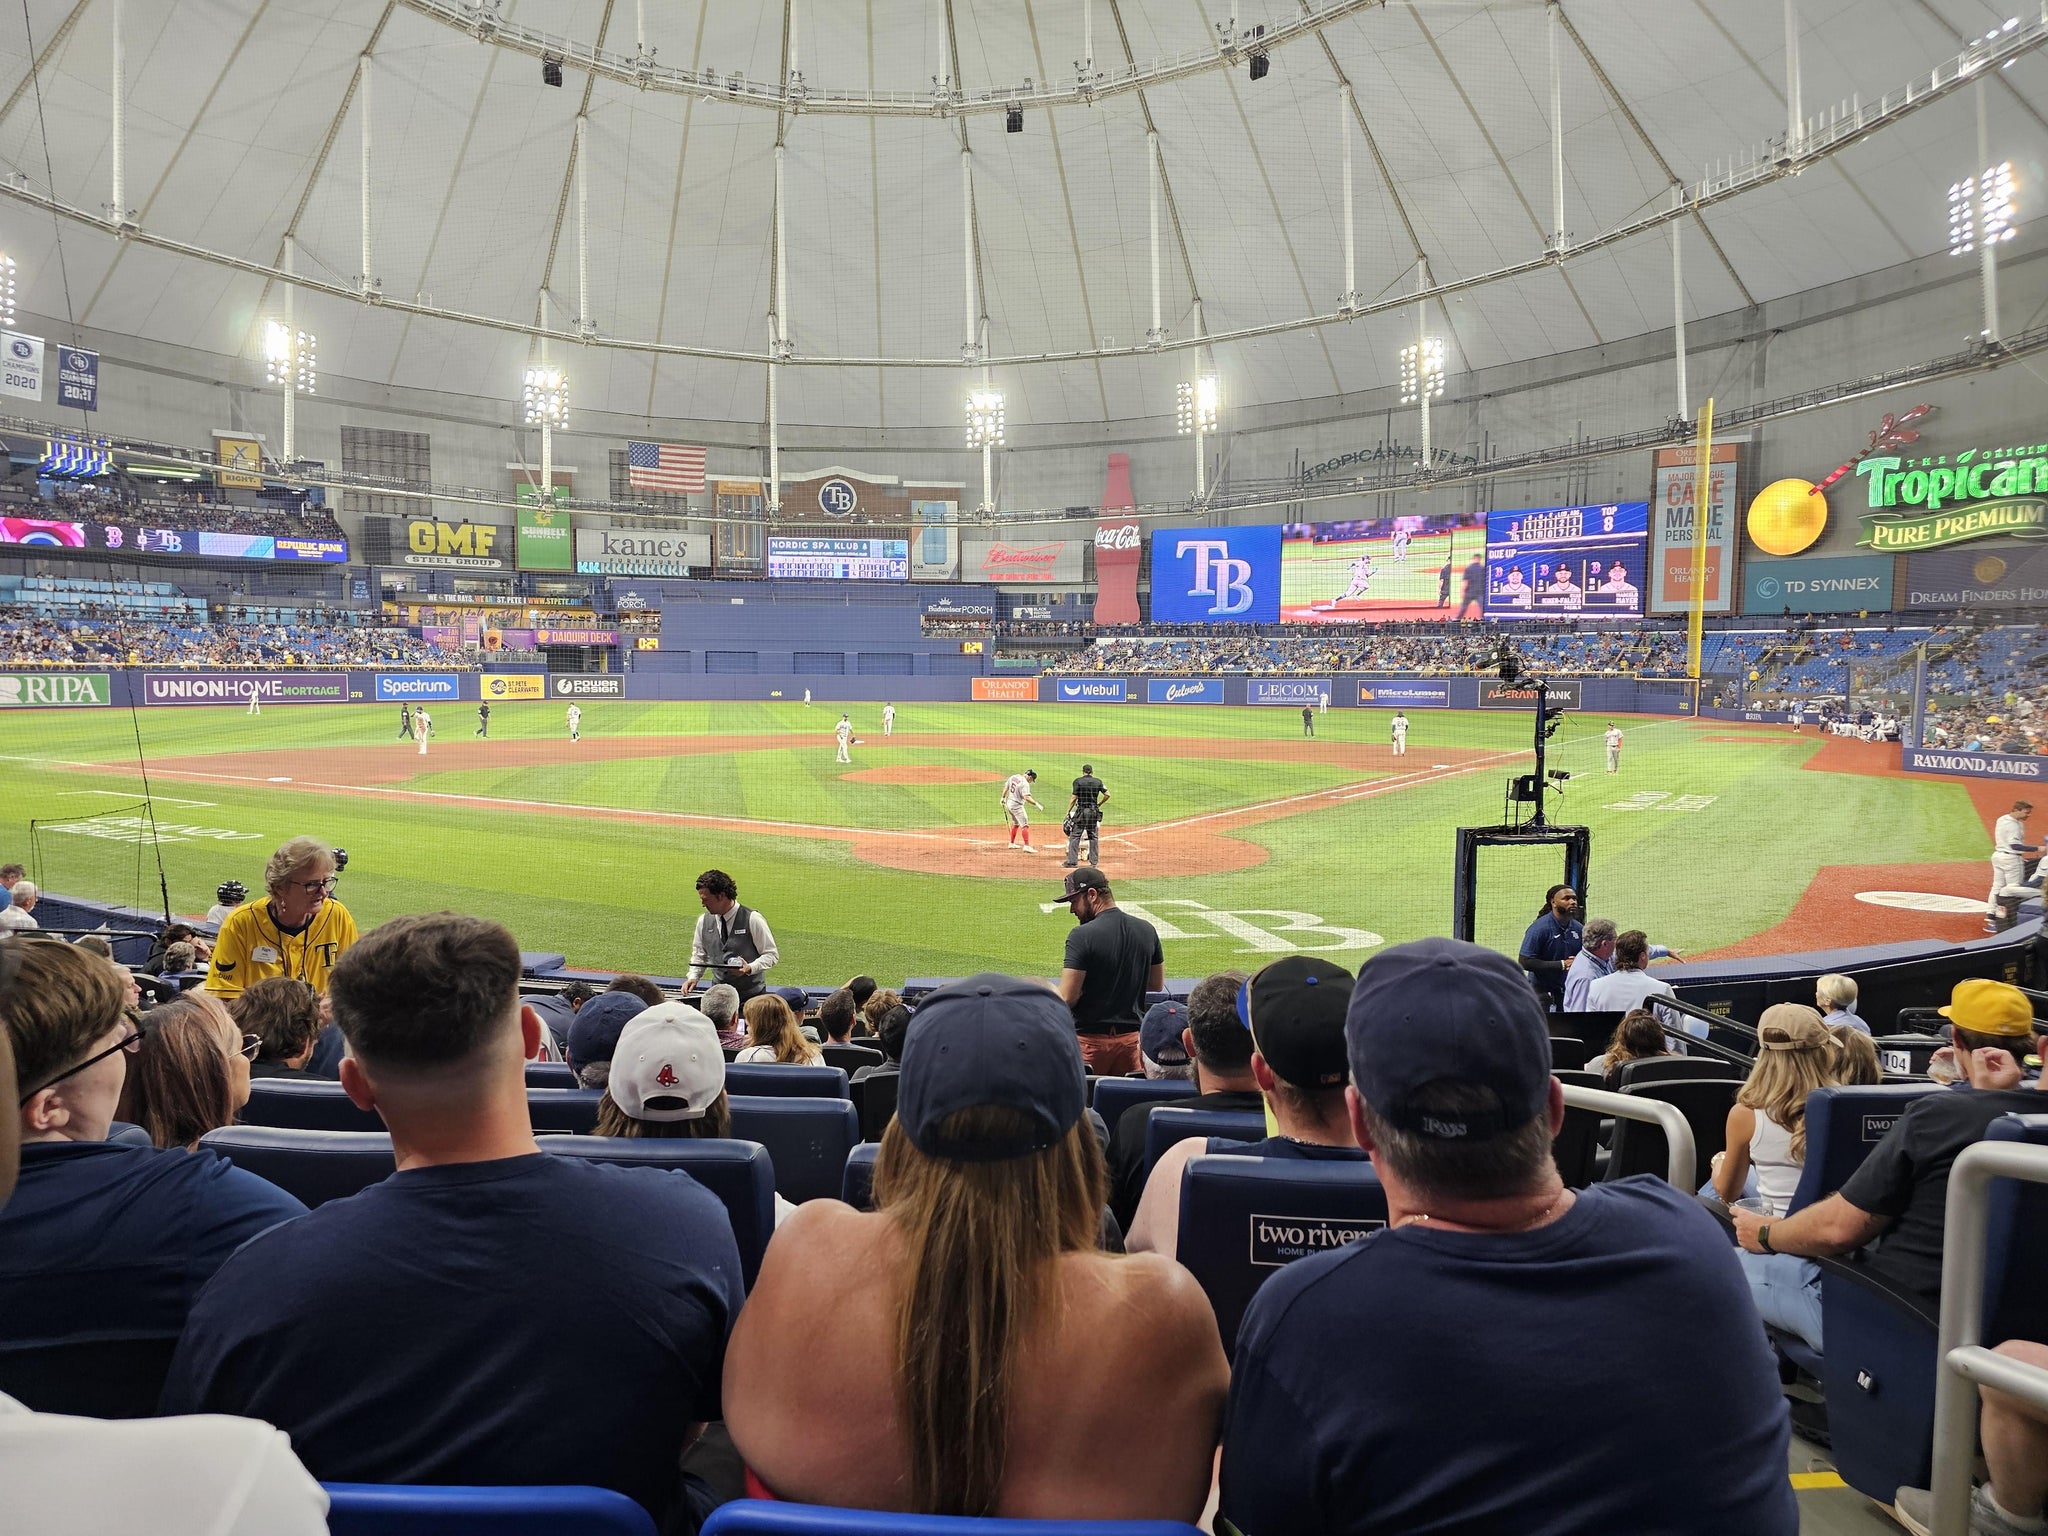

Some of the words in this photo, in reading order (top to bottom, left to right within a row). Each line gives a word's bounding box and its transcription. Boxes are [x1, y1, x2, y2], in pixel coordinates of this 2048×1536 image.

[5, 373, 36, 390] 2020
[1907, 456, 1947, 468] THE
[1668, 472, 1694, 482] MAJOR
[1856, 456, 2048, 510] Tropican
[1602, 506, 1618, 516] TOP
[1604, 516, 1614, 532] 8
[1873, 524, 1930, 546] PURE
[1934, 505, 2045, 539] PREMIUM
[408, 521, 496, 556] GMF
[1094, 525, 1141, 550] Coca-Cola
[1526, 532, 1532, 540] 4
[1558, 529, 1564, 537] 7
[1571, 528, 1577, 536] 2
[276, 540, 318, 550] REPUBLIC
[318, 542, 343, 552] BANK
[601, 532, 688, 558] kane's
[772, 541, 808, 550] NORDIC
[812, 542, 830, 550] SPA
[834, 542, 859, 550] KLUB
[988, 548, 1056, 562] Budweiser
[1488, 550, 1504, 559] DUE
[1505, 549, 1517, 558] UP
[890, 560, 906, 572] 0-0
[1784, 581, 1806, 593] TD
[1810, 577, 1880, 592] SYNNEX
[444, 594, 457, 602] THE
[458, 594, 474, 602] RAYS.
[475, 594, 484, 602] WE
[1910, 592, 1958, 604] DREAM
[1961, 590, 2017, 602] FINDERS
[928, 605, 961, 613] Budweiser
[962, 606, 992, 614] PORCH
[552, 631, 589, 643] DAIQUIRI
[590, 632, 613, 644] DECK
[24, 676, 100, 703] RIPA
[382, 678, 447, 696] Spectrum
[982, 680, 1030, 689] ORLANDO
[1082, 684, 1120, 696] Webull
[283, 686, 340, 696] MORTGAGE
[988, 690, 1024, 698] HEALTH
[1166, 682, 1205, 701] Culver's
[1488, 689, 1538, 699] AERANT
[1913, 754, 1987, 771] RAYMOND
[1986, 759, 2040, 776] JAMES
[1010, 782, 1021, 794] 5
[1884, 1052, 1906, 1071] 104
[1867, 1118, 1891, 1130] two
[1258, 1221, 1305, 1244] two
[1278, 1247, 1305, 1256] HOME
[1856, 1370, 1871, 1390] M
